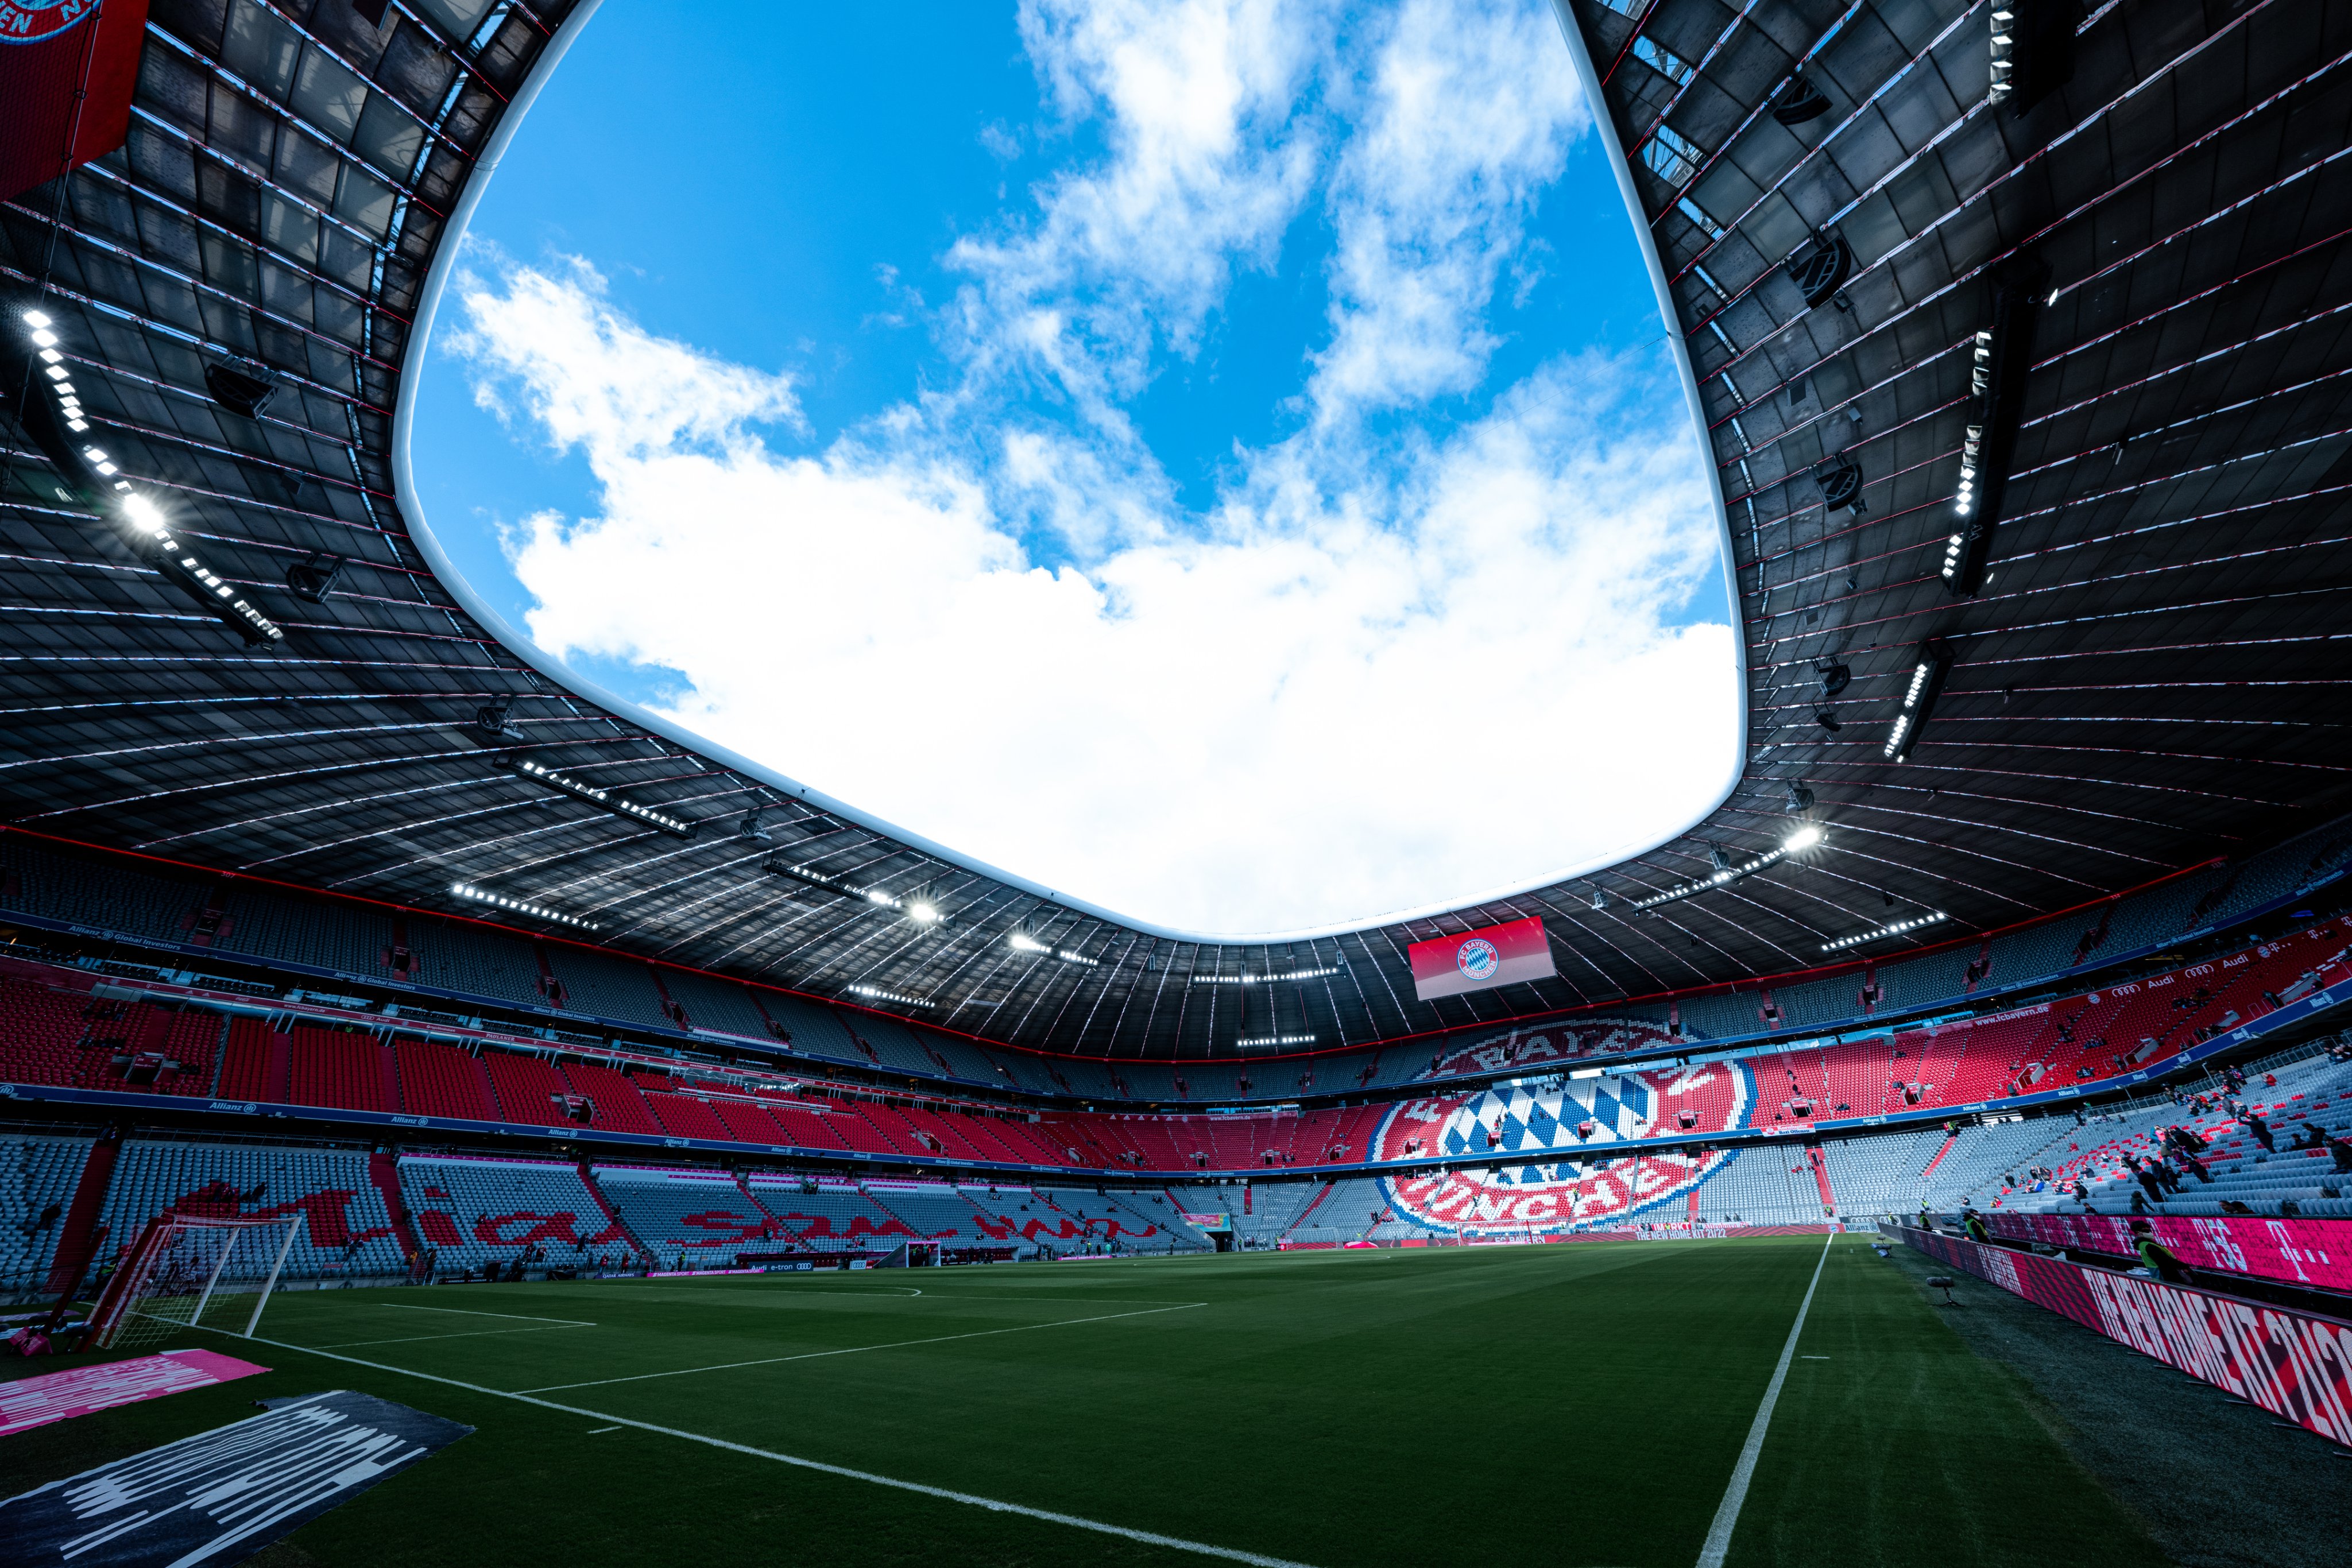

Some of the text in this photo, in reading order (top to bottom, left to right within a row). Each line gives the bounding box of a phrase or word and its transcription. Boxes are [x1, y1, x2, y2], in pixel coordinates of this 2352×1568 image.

[69, 925, 181, 950] Allianz Global Investors
[2178, 932, 2194, 942] Global
[2194, 926, 2215, 936] Investors
[1460, 941, 1494, 959] FC BAYERN
[2223, 954, 2249, 969] Audi
[1463, 960, 1496, 978] MÜNCHEN
[334, 972, 416, 990] Allianz Global Investors
[2038, 974, 2059, 982] Investors
[2148, 975, 2175, 989] Audi
[284, 1004, 326, 1013] www.fcbayern.de
[533, 1006, 550, 1014] Allianz
[1975, 1006, 2049, 1026] www.fcbayern.de
[485, 1033, 515, 1042] PAULANER
[209, 1102, 242, 1111] Allianz
[391, 1116, 417, 1124] Allianz
[1508, 1236, 1546, 1244] BAYERN
[1635, 1231, 1651, 1241] THE
[1651, 1230, 1669, 1240] NEW
[1669, 1229, 1692, 1240] HOME
[1692, 1229, 1705, 1239] KIT
